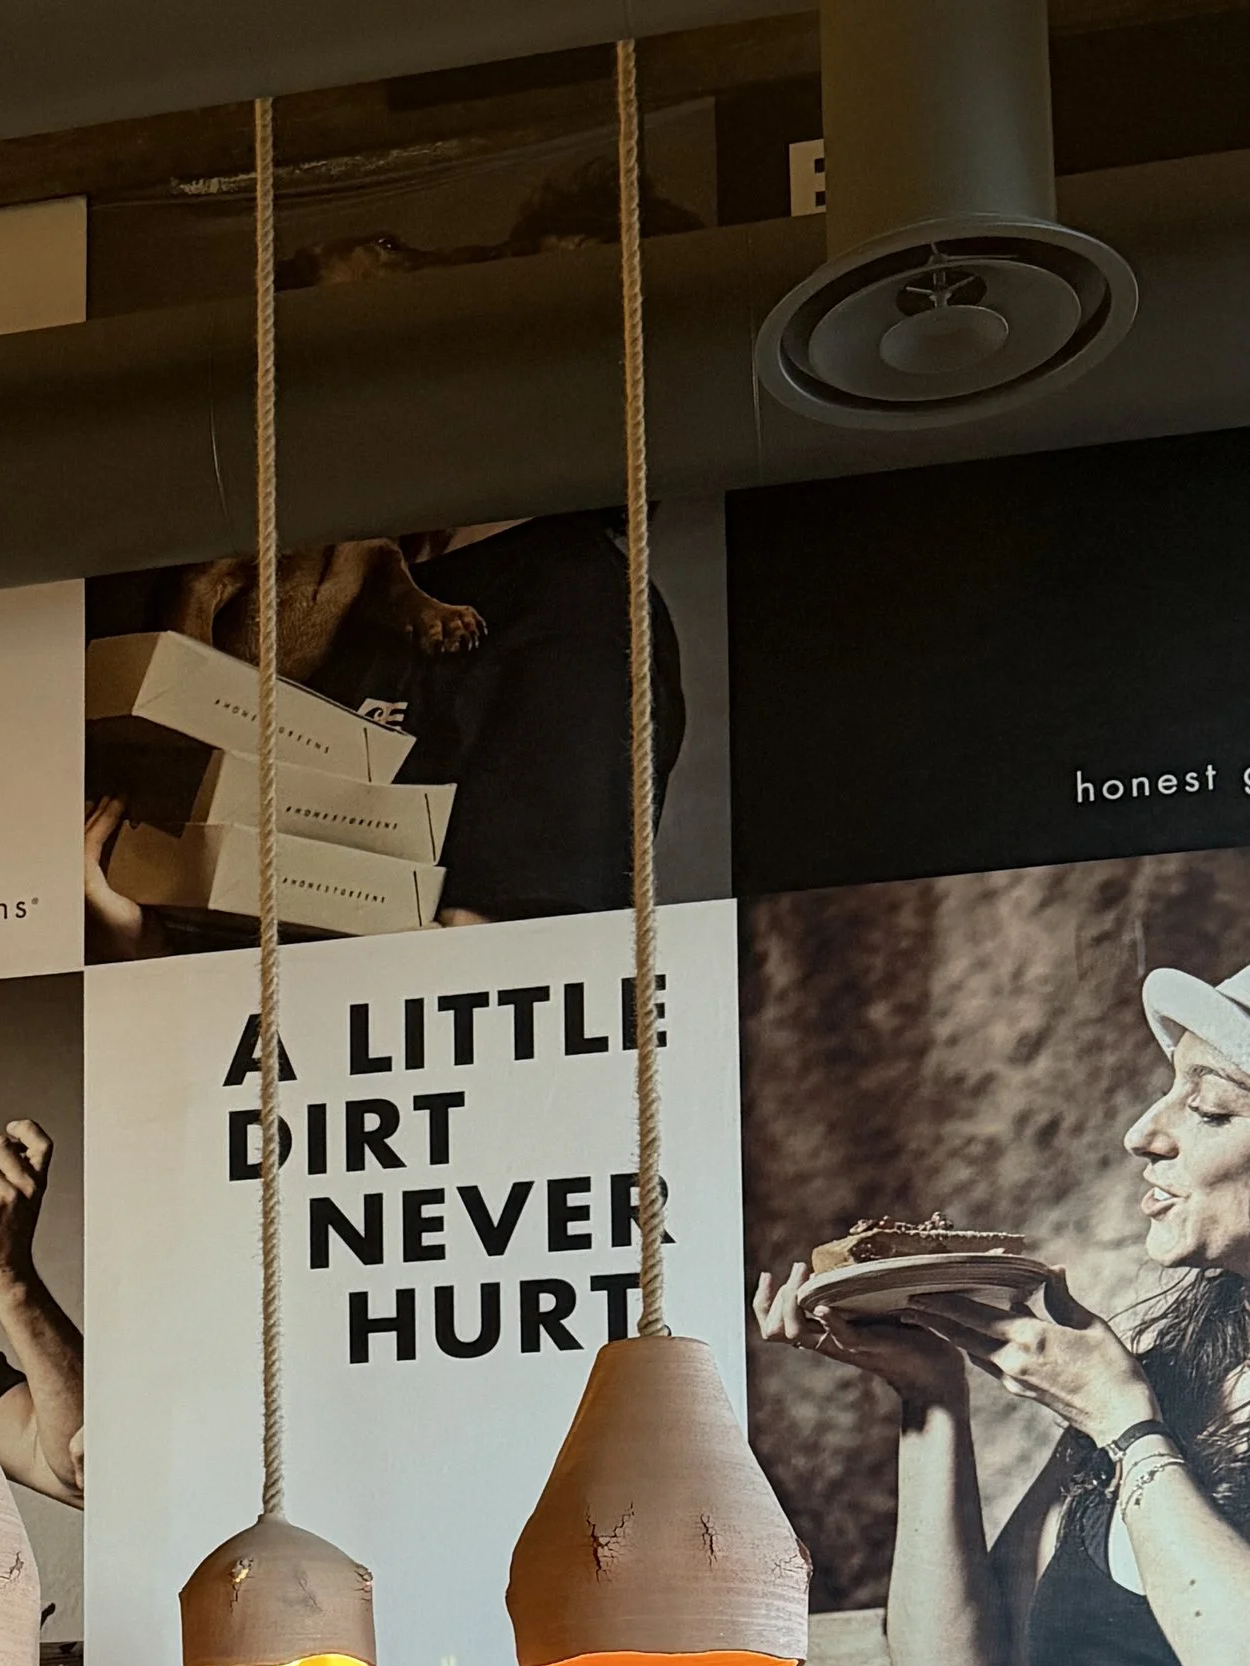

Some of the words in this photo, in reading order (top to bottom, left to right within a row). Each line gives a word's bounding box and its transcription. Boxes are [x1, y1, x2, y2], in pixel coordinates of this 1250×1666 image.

[1077, 764, 1216, 803] honest
[223, 1013, 297, 1087] A
[350, 974, 667, 1075] LITTLE
[229, 1091, 465, 1181] DIRT
[310, 1173, 676, 1269] NEVER
[349, 1273, 671, 1364] HURT
